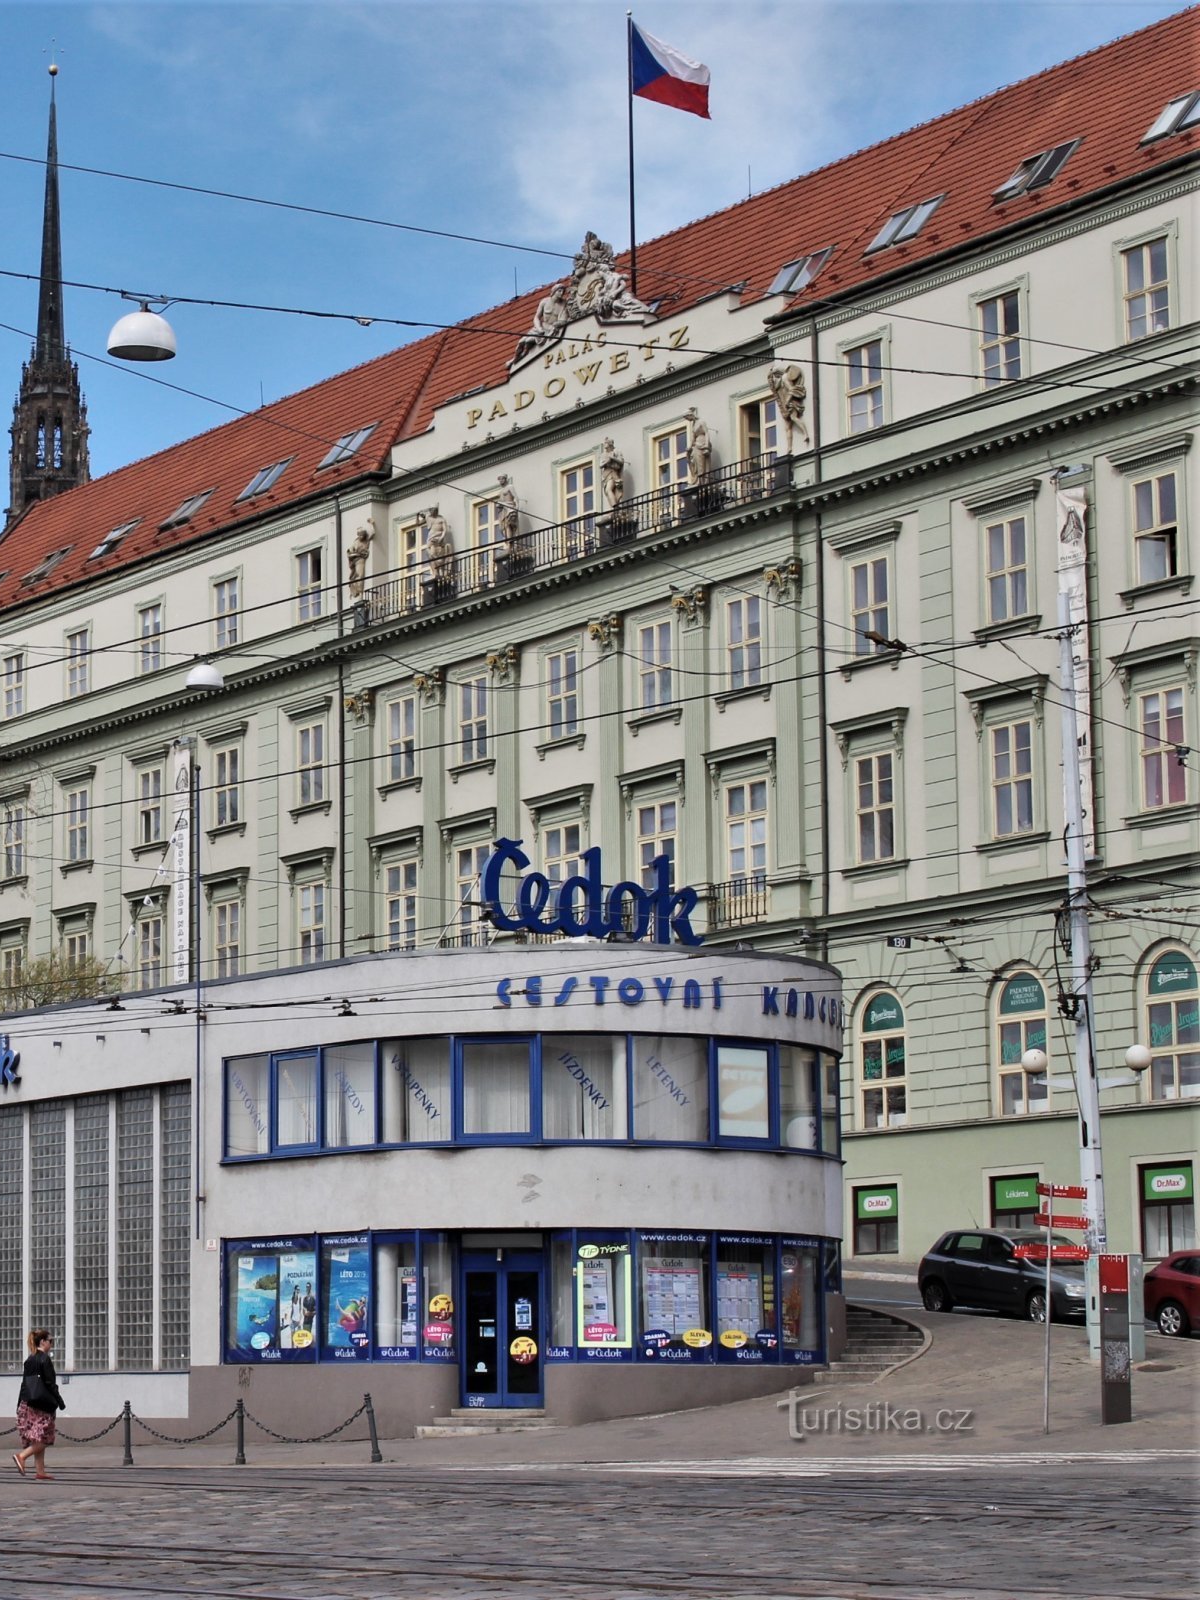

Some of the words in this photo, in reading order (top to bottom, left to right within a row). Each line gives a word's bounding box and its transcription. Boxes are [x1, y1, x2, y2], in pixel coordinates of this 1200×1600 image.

[544, 331, 607, 369] PALÁC
[467, 325, 689, 429] PADOWETZ
[480, 837, 705, 946] Čedok
[893, 937, 906, 948] 130
[496, 975, 724, 1010] CESTOVNÍ
[1009, 984, 1039, 996] PADOWETZ
[391, 1053, 441, 1120] VSTUPENKY
[557, 1052, 611, 1111] JÍZDENKY
[645, 1055, 692, 1108] LETENKY
[231, 1071, 268, 1136] UBYTOVÁNÍ
[324, 1236, 368, 1245] www.cedok.cz
[641, 1234, 707, 1242] www.cedok.cz
[720, 1235, 773, 1245] www.cedok.cz
[251, 1241, 293, 1249] www.cedok.cz
[600, 1244, 629, 1255] TÝDNE
[340, 1270, 353, 1278] LÉTO
[427, 1325, 441, 1333] LÉTO
[588, 1326, 602, 1334] LÉTO
